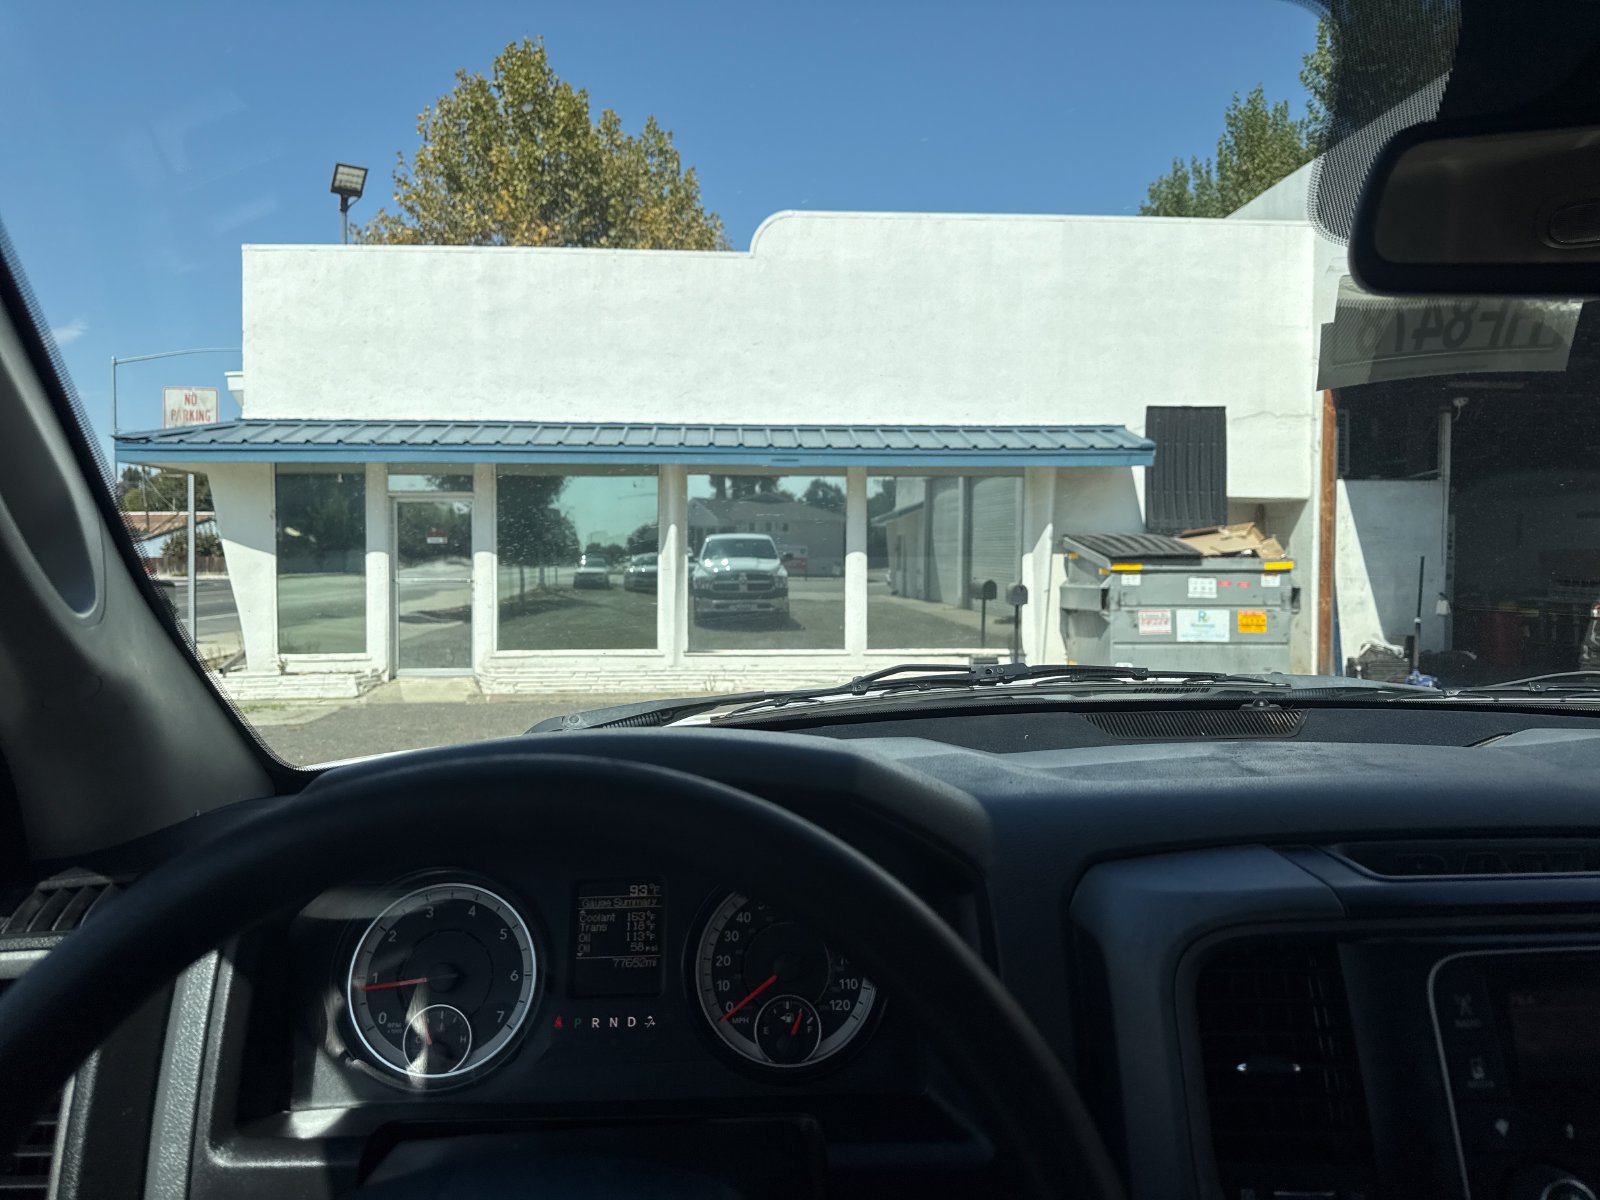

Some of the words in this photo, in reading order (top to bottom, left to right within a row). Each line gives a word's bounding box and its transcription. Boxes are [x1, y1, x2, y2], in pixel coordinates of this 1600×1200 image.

[184, 391, 198, 407] NO
[170, 407, 211, 422] PARKING
[582, 898, 612, 909] Gauge
[614, 898, 657, 908] Summary
[425, 906, 435, 919] 3
[467, 904, 477, 917] 4
[579, 912, 616, 922] Coolant
[735, 911, 752, 924] 40
[579, 923, 608, 932] Trans
[388, 929, 398, 943] 2
[499, 928, 509, 941] 5
[578, 932, 592, 942] Oil
[723, 930, 740, 942] 30
[577, 943, 591, 953] Oil
[715, 955, 731, 967] 20
[372, 972, 379, 984] 1
[510, 970, 519, 982] 6
[716, 980, 731, 991] 10
[839, 978, 859, 990] 110
[725, 1001, 735, 1013] 0
[829, 999, 851, 1011] 120
[377, 1012, 387, 1025] 0
[496, 1011, 505, 1023] 7
[574, 1018, 582, 1029] P
[591, 1017, 600, 1029] R
[609, 1016, 618, 1028] N
[627, 1016, 637, 1027] D
[731, 1016, 750, 1024] MPH
[763, 1026, 770, 1035] E
[807, 1025, 814, 1034] F
